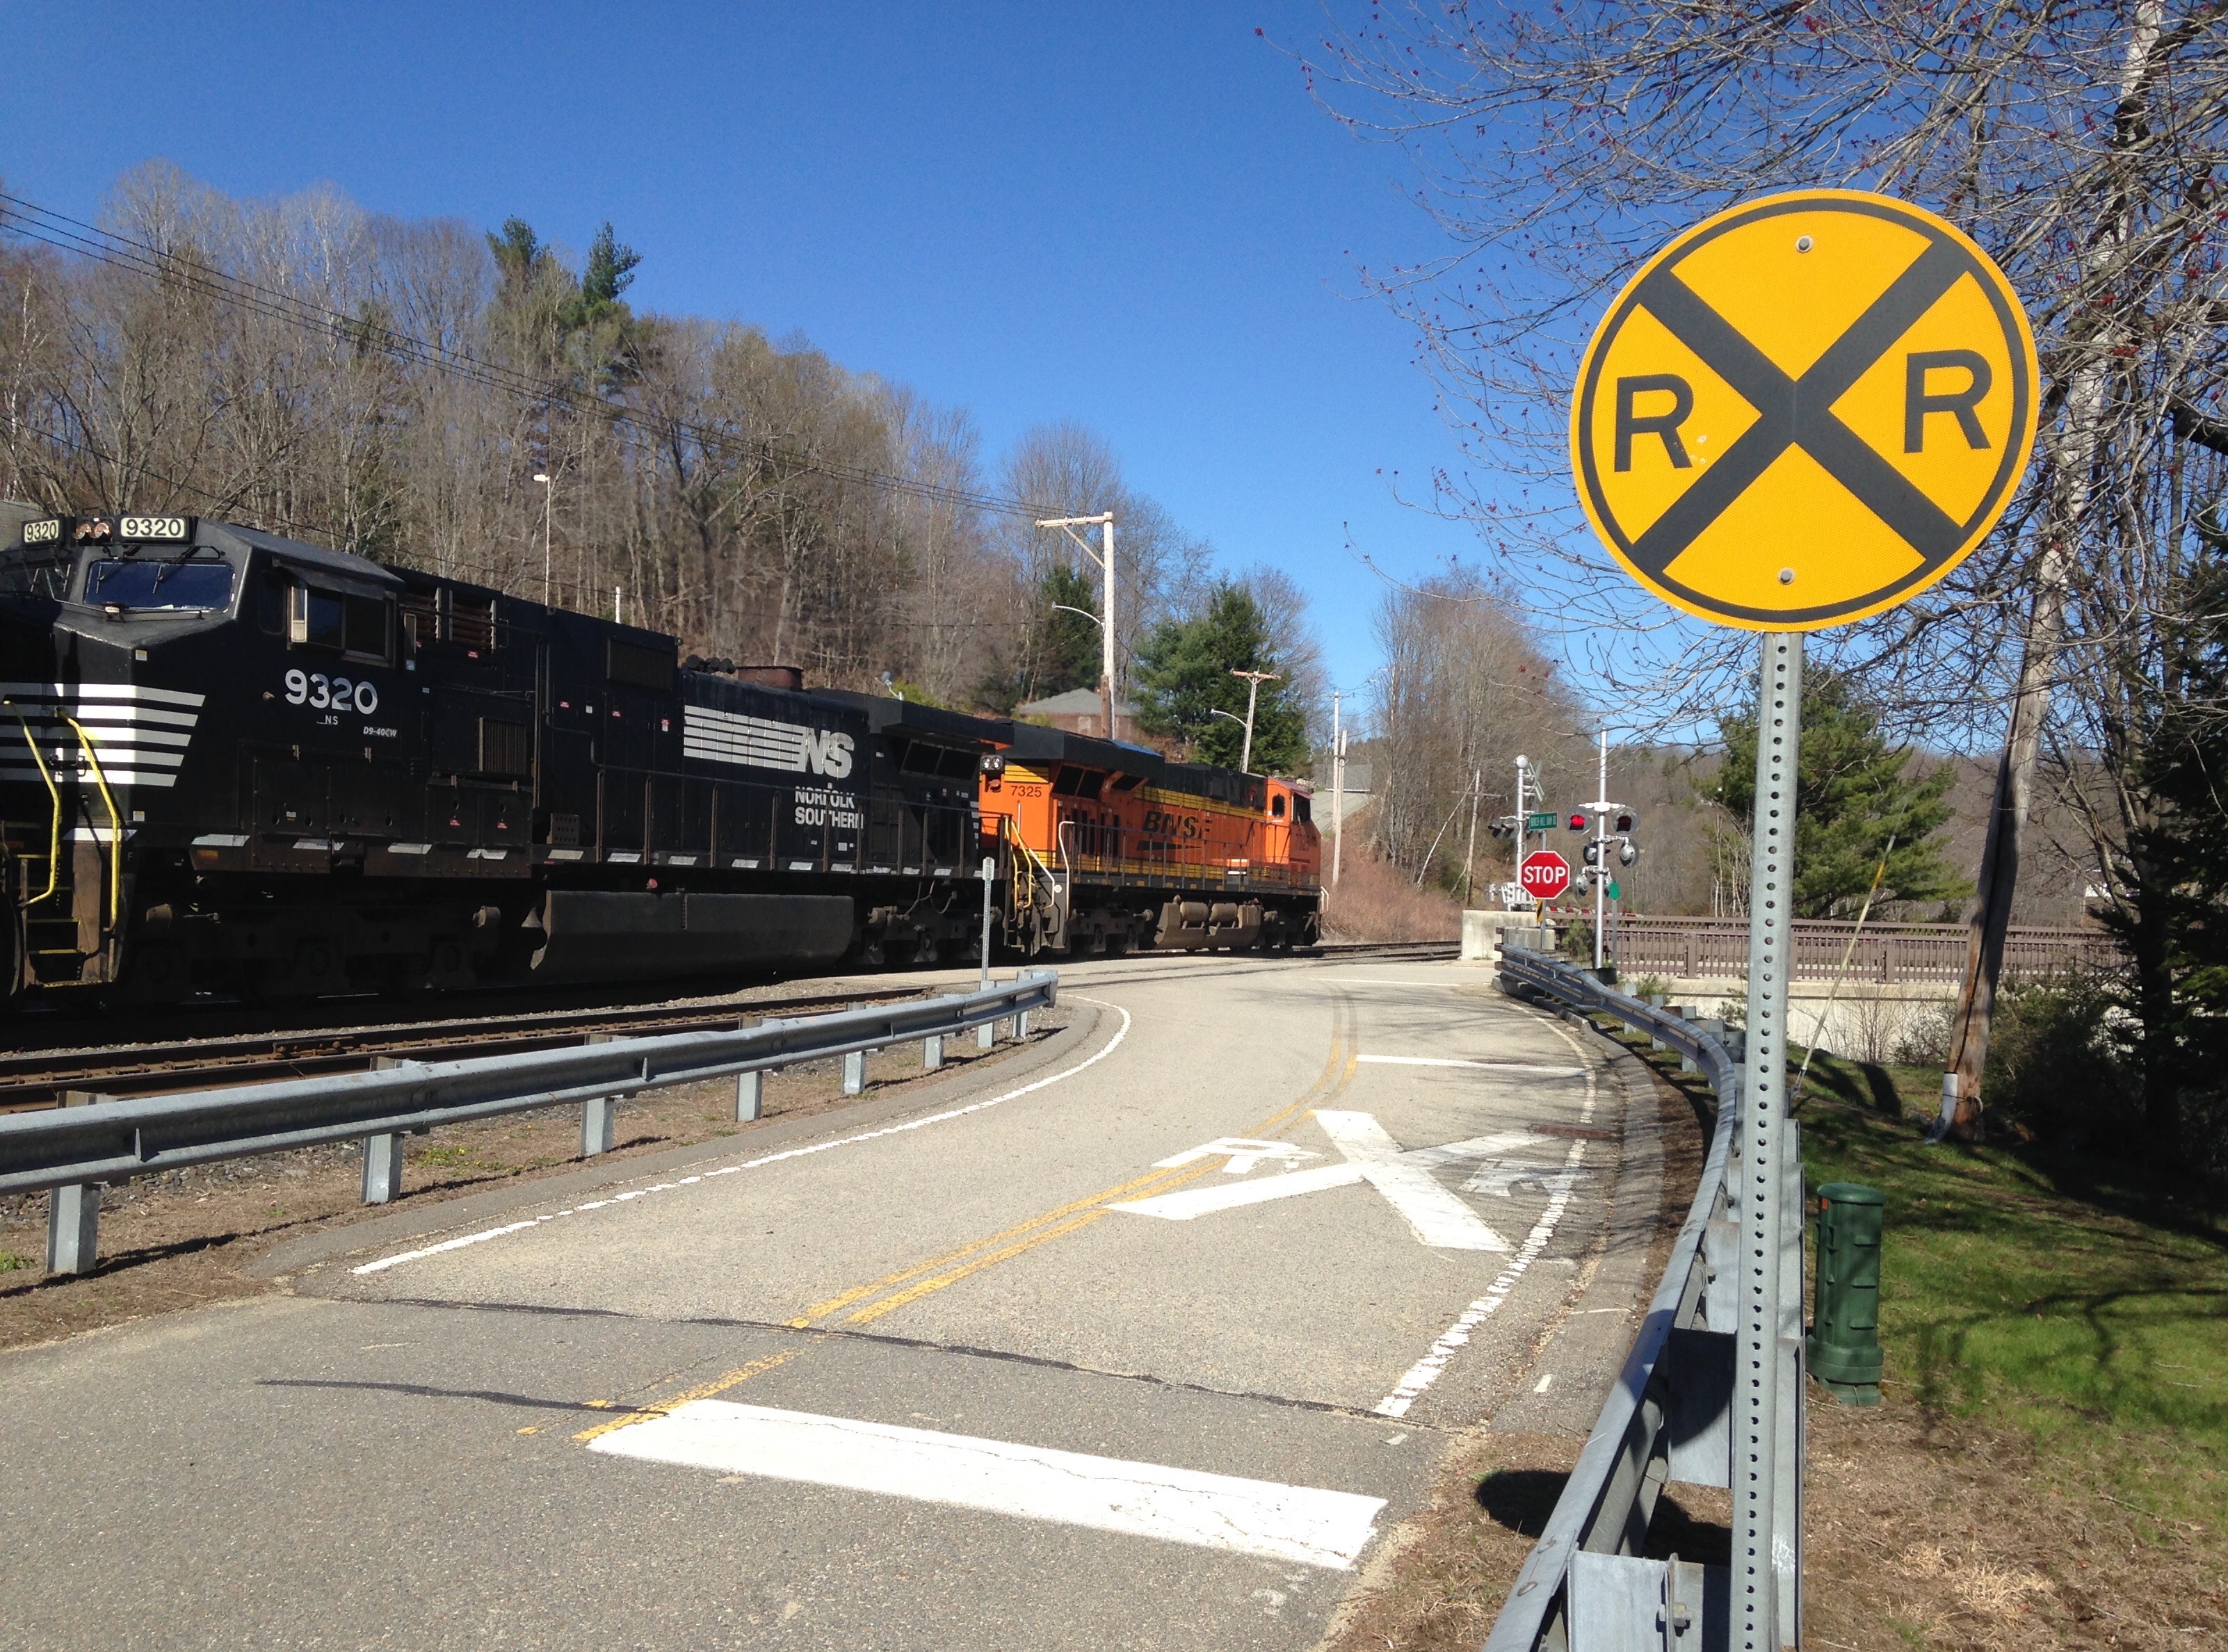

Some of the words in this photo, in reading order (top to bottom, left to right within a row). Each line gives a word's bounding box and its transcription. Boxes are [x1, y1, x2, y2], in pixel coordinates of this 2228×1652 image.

[1615, 373, 1694, 472] R
[1904, 349, 1992, 453] R
[26, 522, 57, 541] 9320
[126, 519, 181, 536] 9320
[284, 669, 378, 715] 9320
[325, 715, 339, 725] NS
[805, 727, 855, 779] NS
[1010, 785, 1042, 797] 7325
[1524, 866, 1565, 883] STOP
